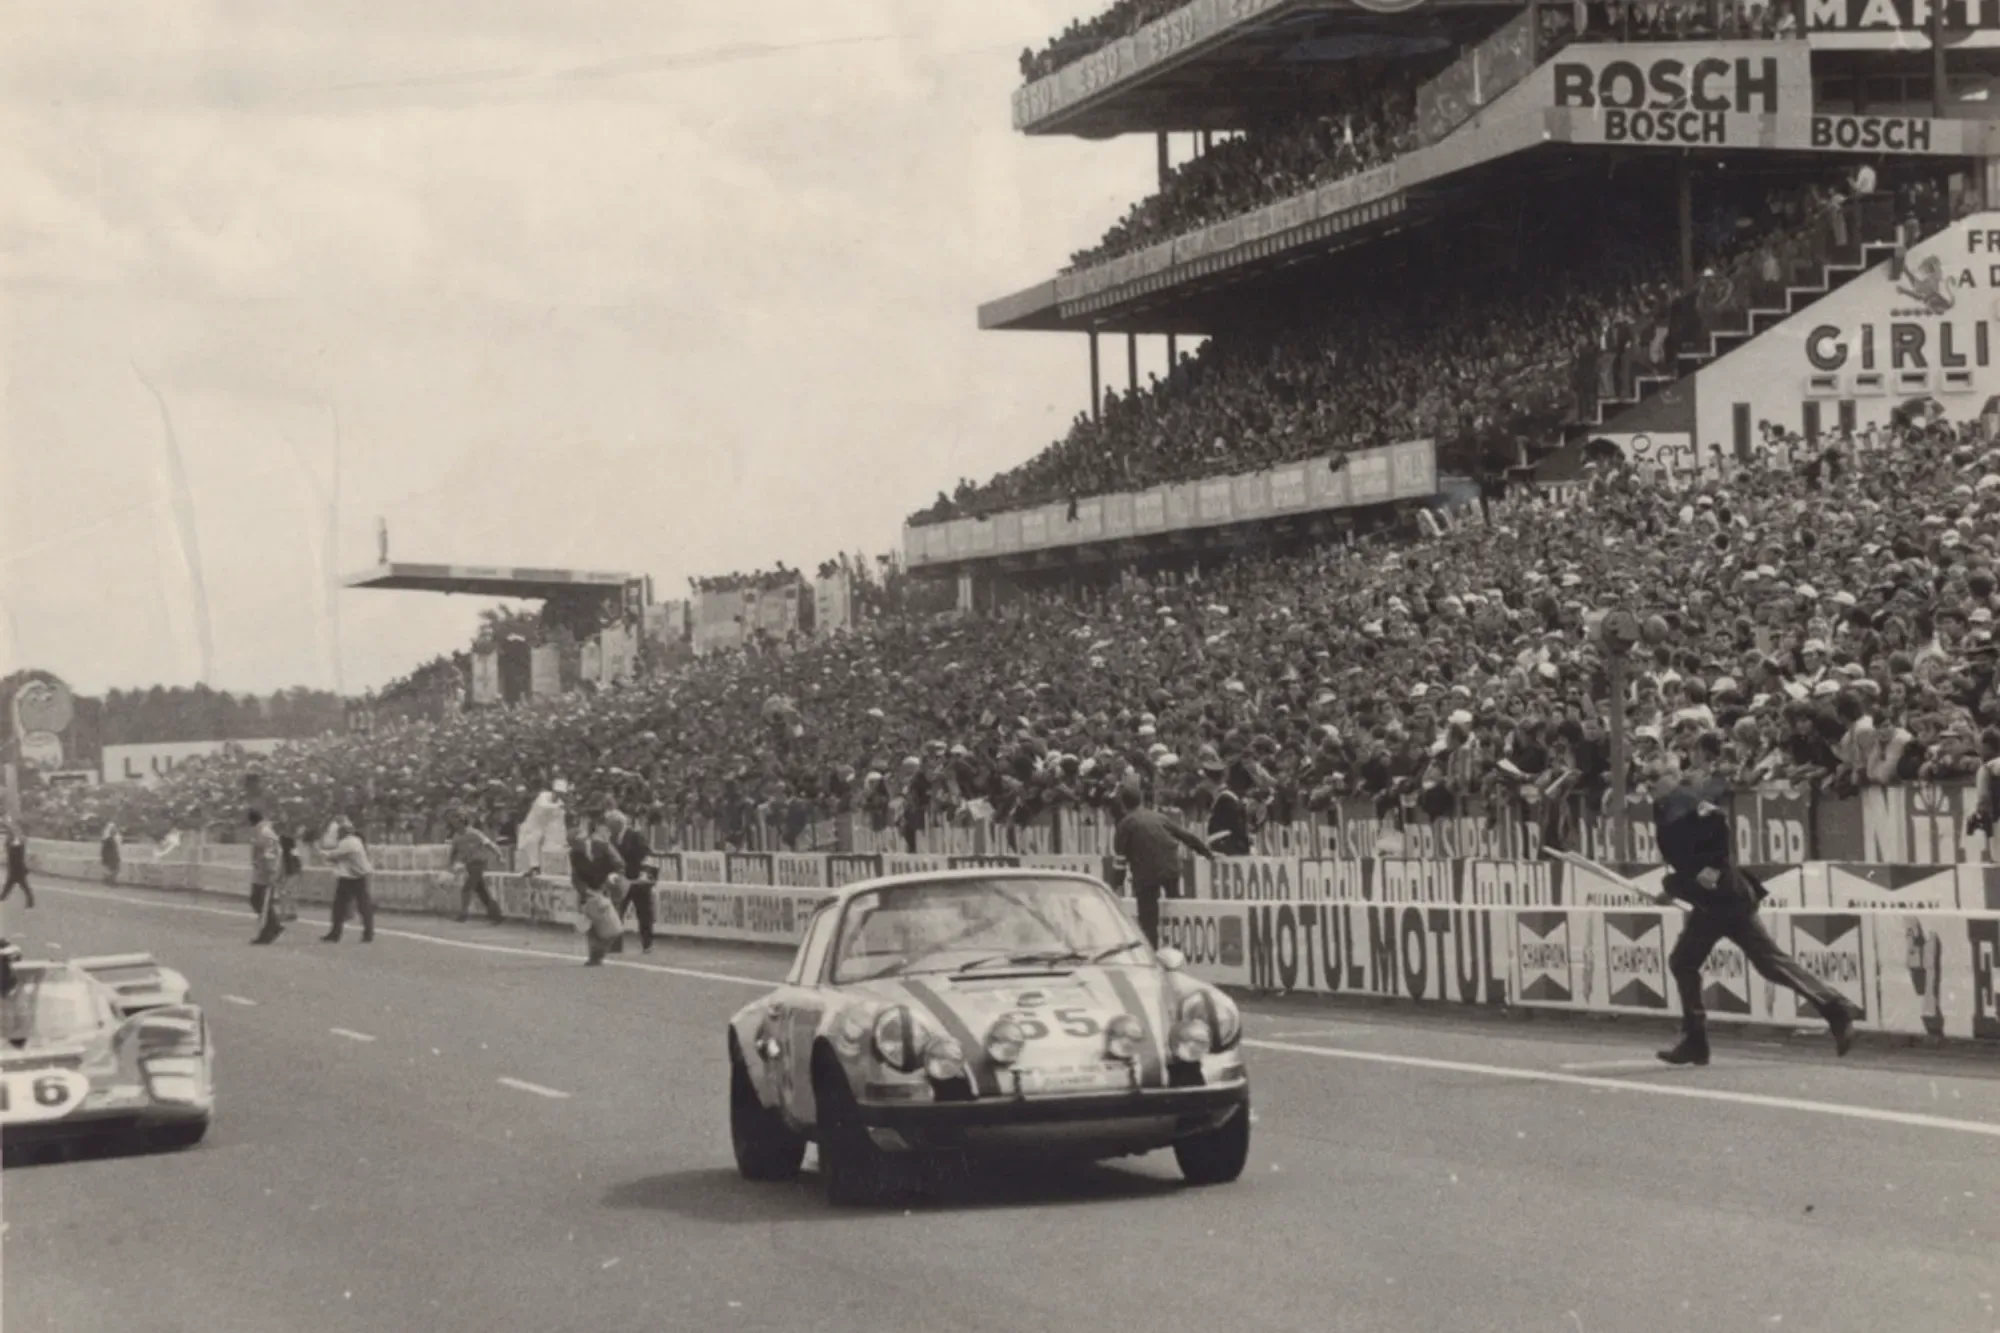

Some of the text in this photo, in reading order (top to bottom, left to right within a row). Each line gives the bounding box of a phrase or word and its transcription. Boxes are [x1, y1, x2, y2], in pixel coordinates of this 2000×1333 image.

[1554, 56, 1778, 114] BOSCH
[1604, 109, 1727, 144] BOSCH
[1811, 116, 1931, 151] BOSCH
[1958, 267, 1977, 289] A
[1248, 904, 1366, 990] MOTUL
[1368, 905, 1505, 1003] MOTUL
[1611, 945, 1660, 975] CHAMPION
